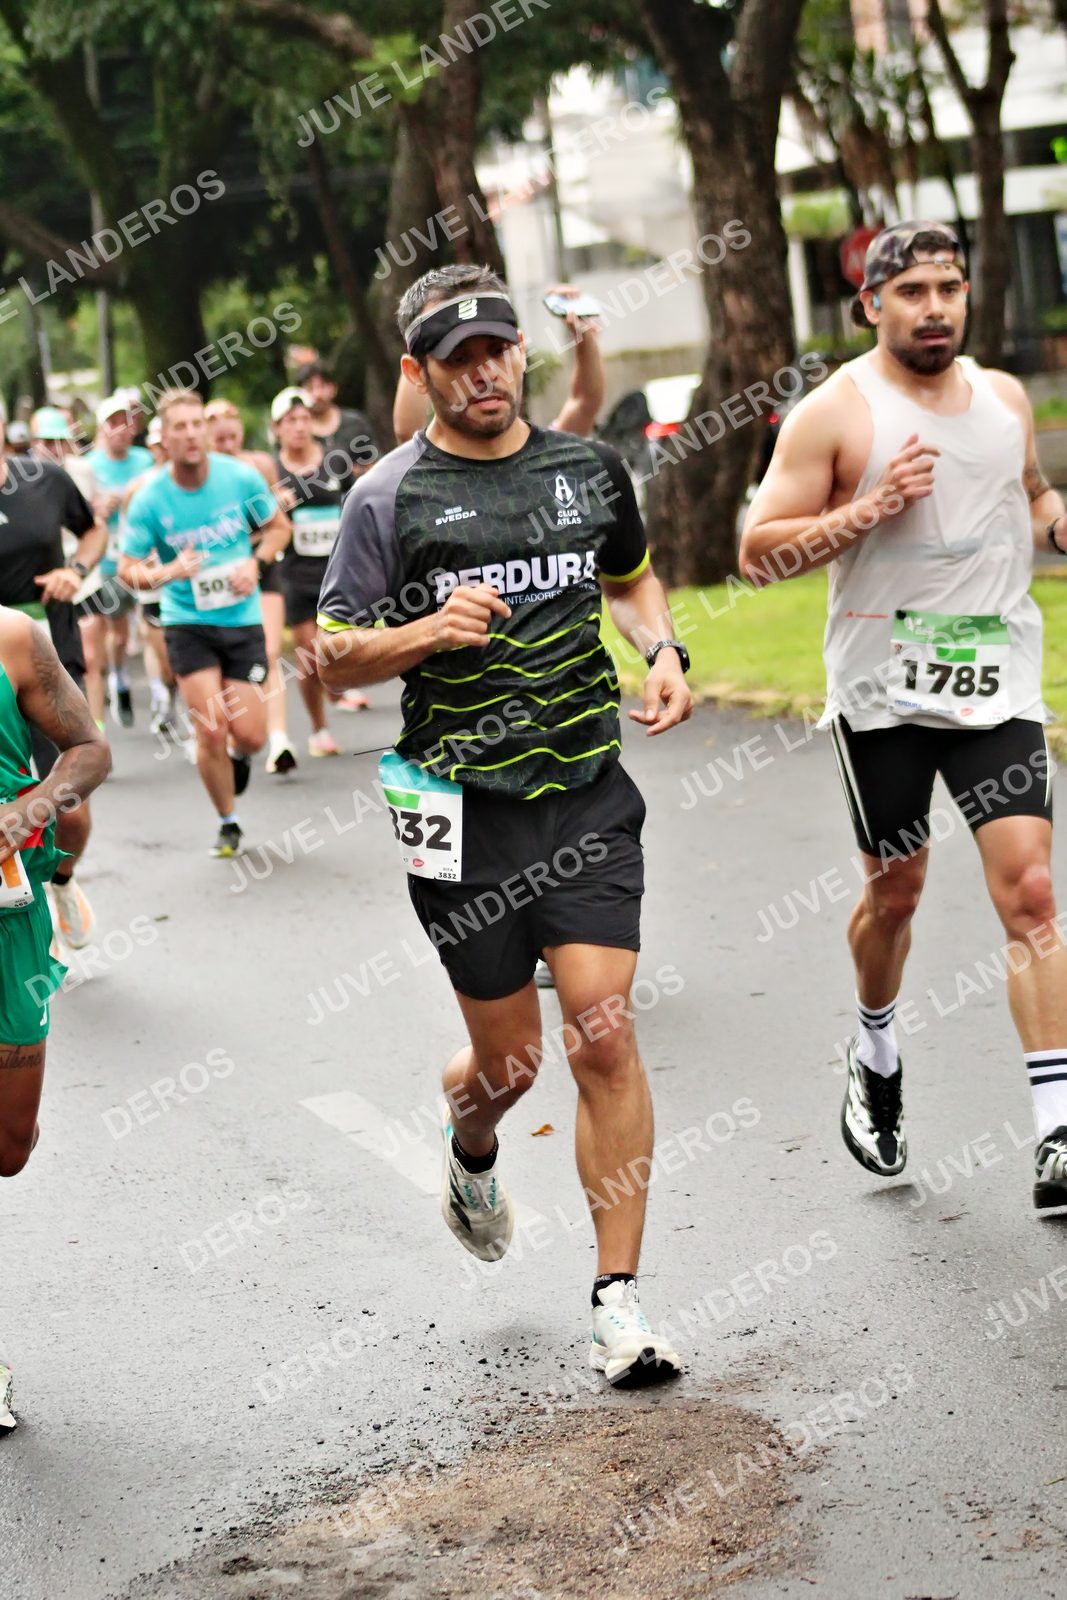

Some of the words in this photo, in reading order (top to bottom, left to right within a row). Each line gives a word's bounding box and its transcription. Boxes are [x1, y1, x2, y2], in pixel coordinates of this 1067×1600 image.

[435, 509, 477, 526] SVEDDA
[557, 509, 579, 518] CLUB
[557, 516, 582, 526] ATLAS
[902, 659, 1000, 698] 1785
[438, 871, 457, 880] 3832
